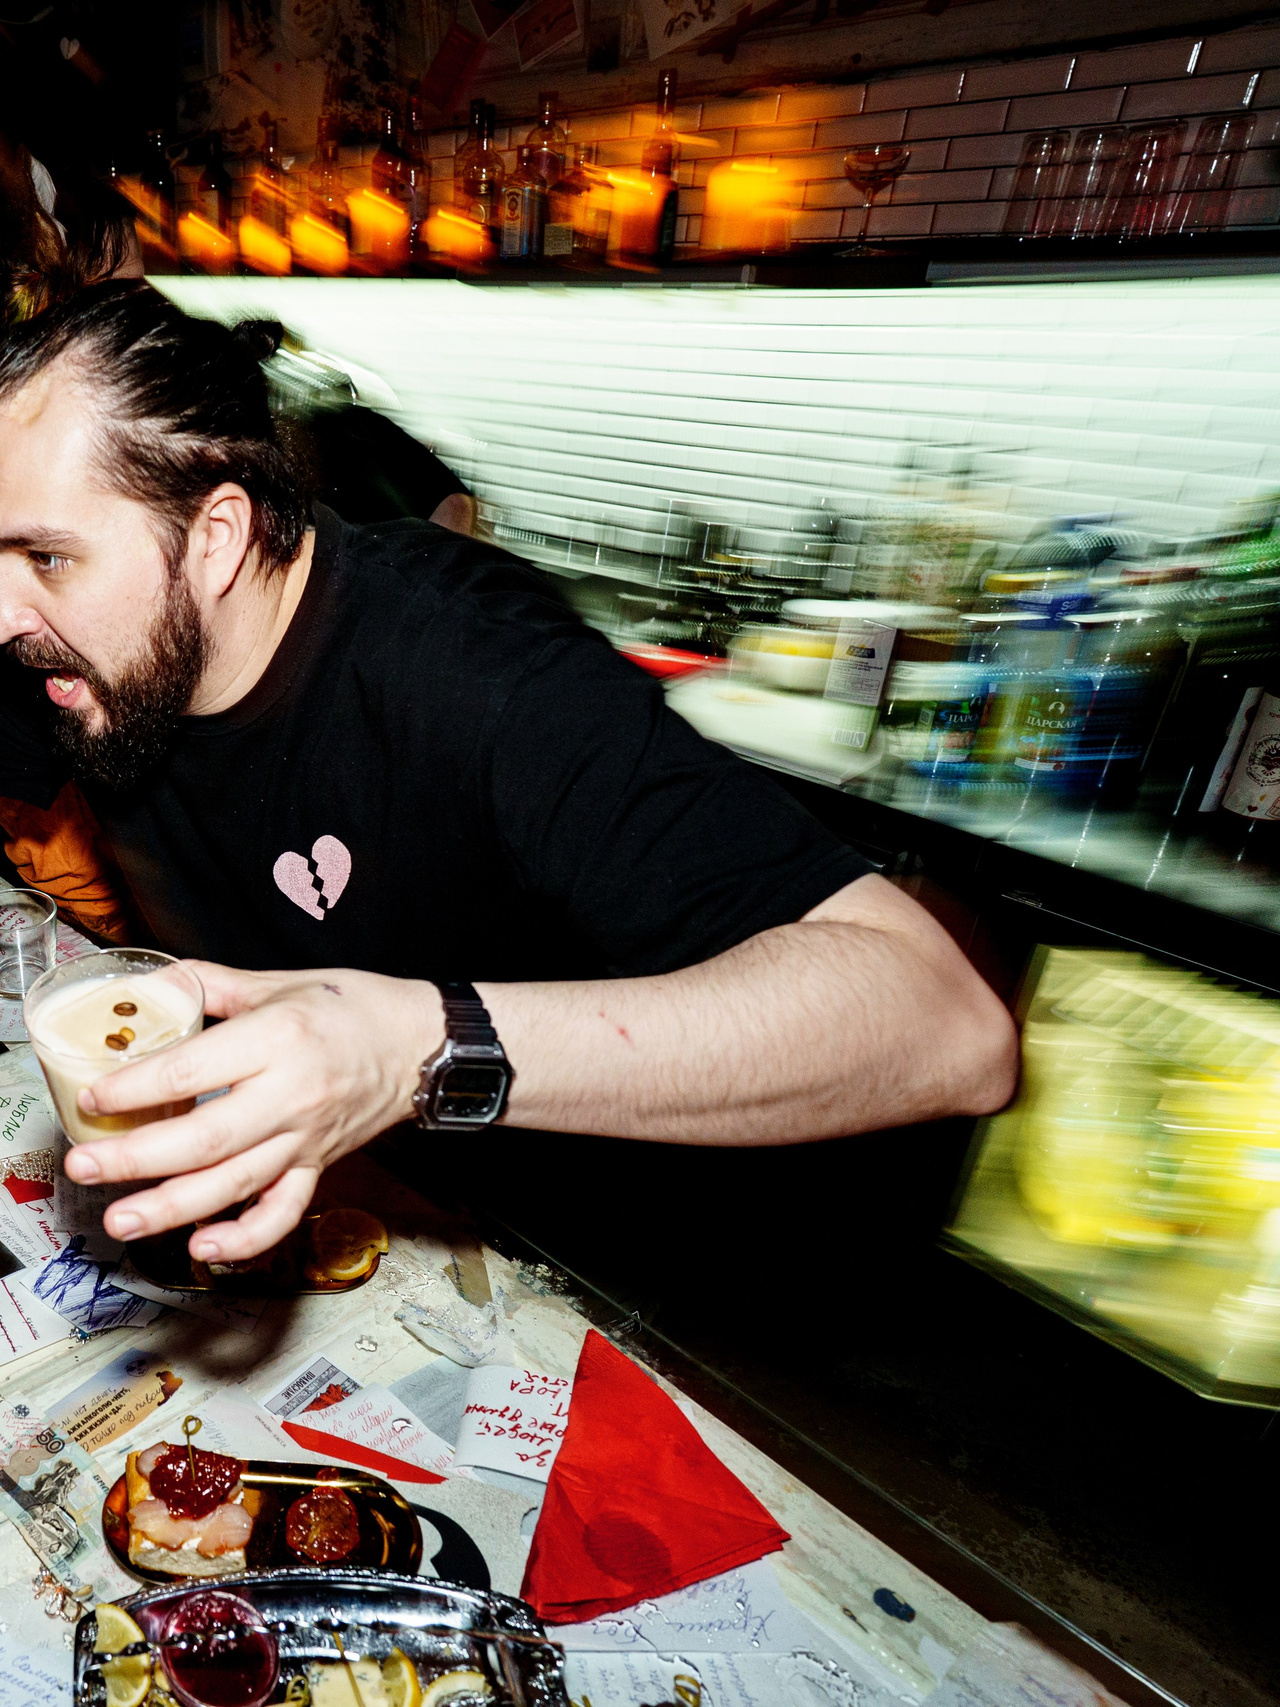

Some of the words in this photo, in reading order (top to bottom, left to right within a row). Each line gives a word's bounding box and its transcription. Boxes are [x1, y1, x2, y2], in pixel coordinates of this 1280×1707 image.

[1026, 715, 1078, 729] ЦАРСКАЯ
[281, 1370, 317, 1401] ПРАВОСУДИЕ
[66, 1421, 83, 1436] АЖИ
[80, 1399, 113, 1426] АЛКОГОЛЮ
[73, 1428, 90, 1443] АЖИ
[88, 1412, 111, 1433] ЖИЗНИ
[36, 1426, 66, 1454] 50
